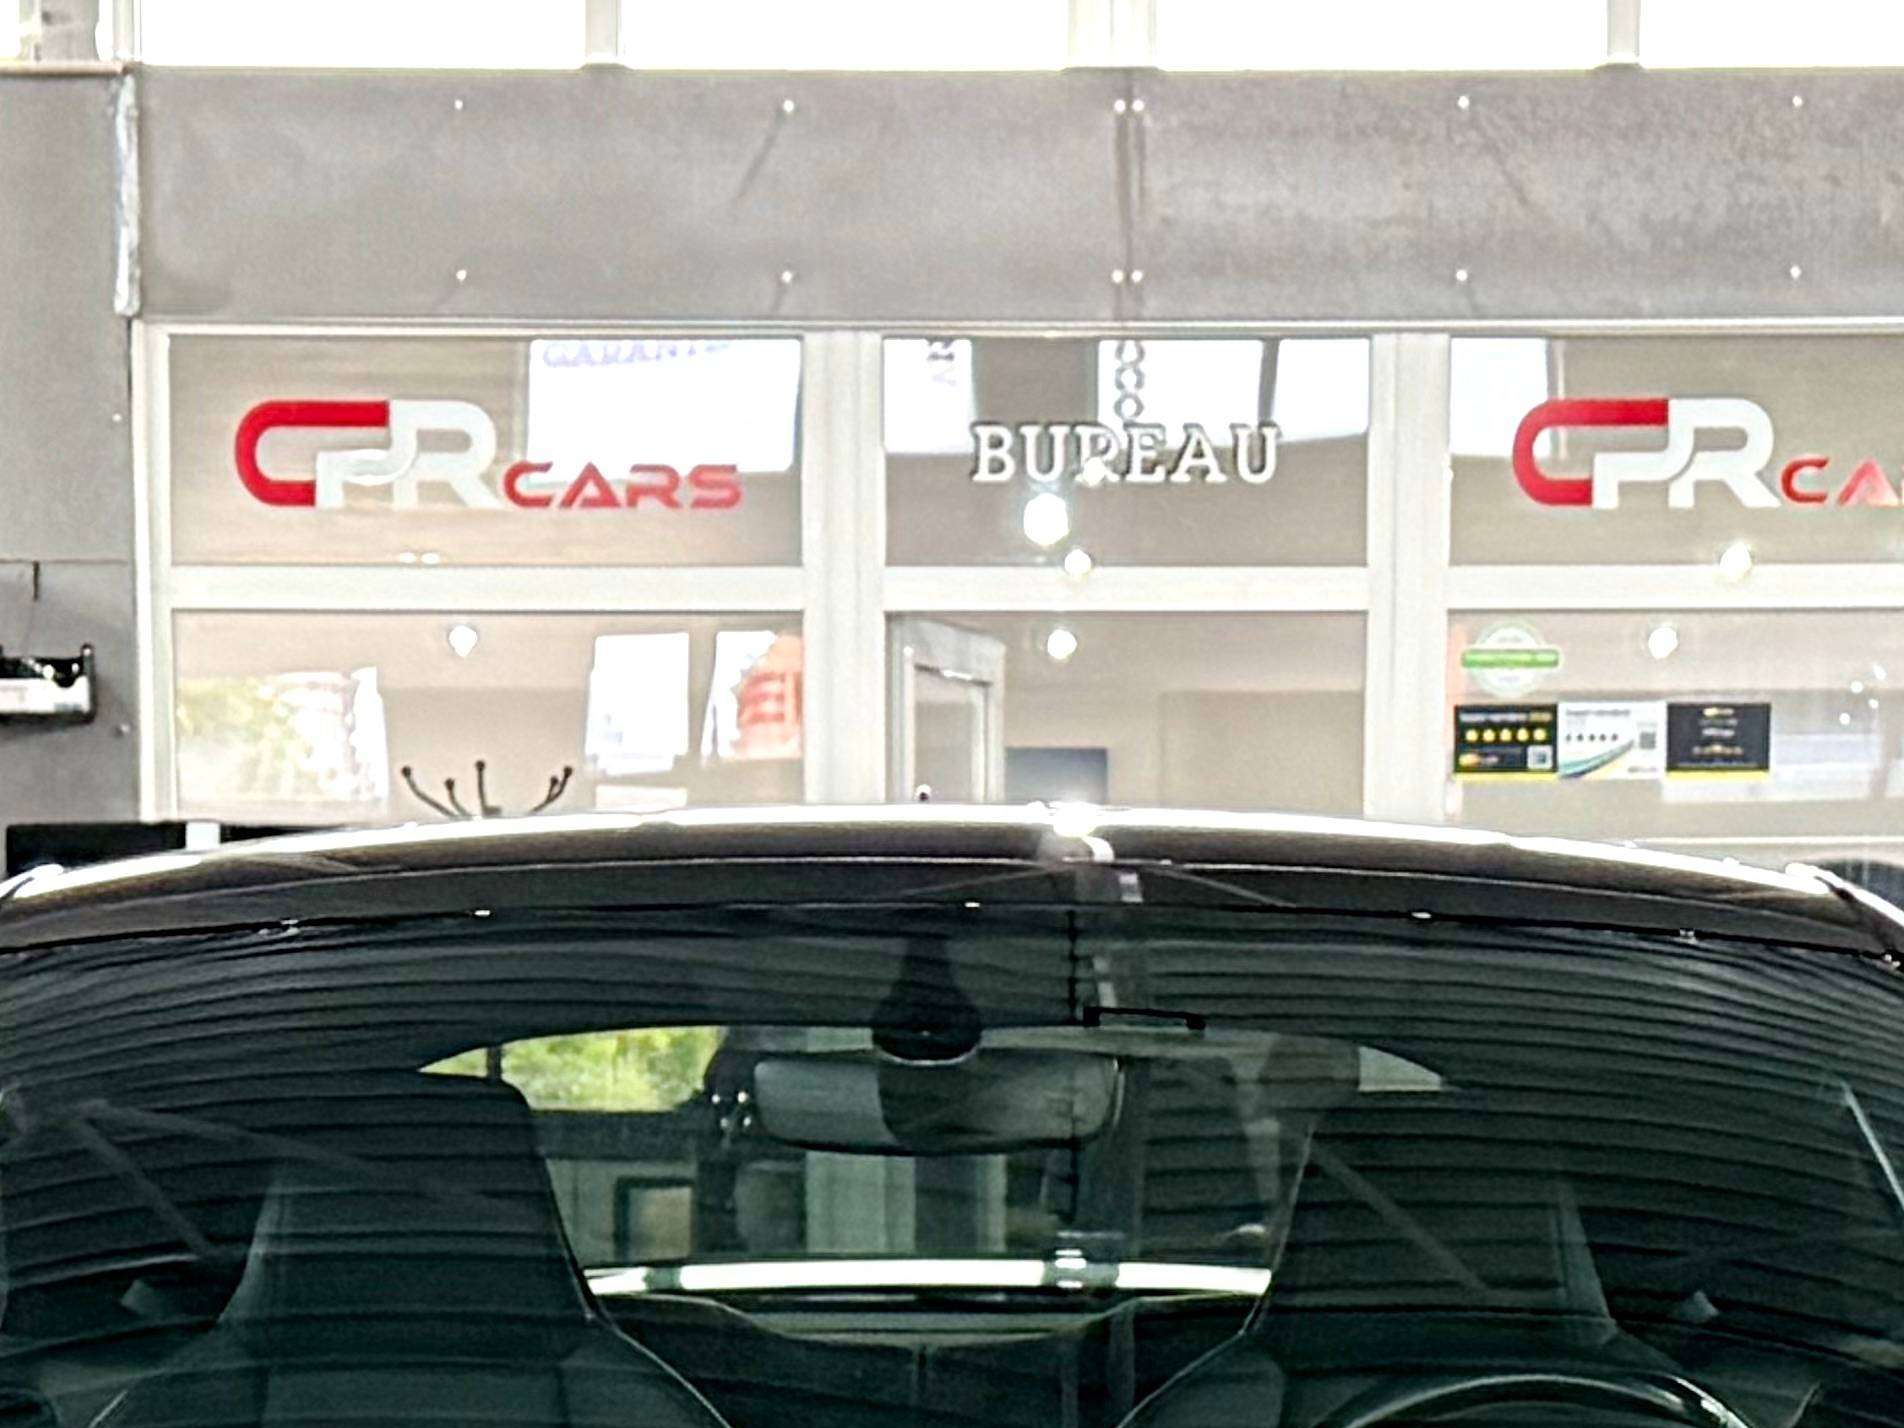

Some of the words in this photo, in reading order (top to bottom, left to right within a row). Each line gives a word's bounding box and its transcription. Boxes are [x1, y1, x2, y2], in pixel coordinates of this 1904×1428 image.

[235, 399, 498, 508] CPR
[503, 461, 742, 509] CARS
[971, 422, 1282, 484] BUREAU
[1512, 398, 1780, 508] CPR
